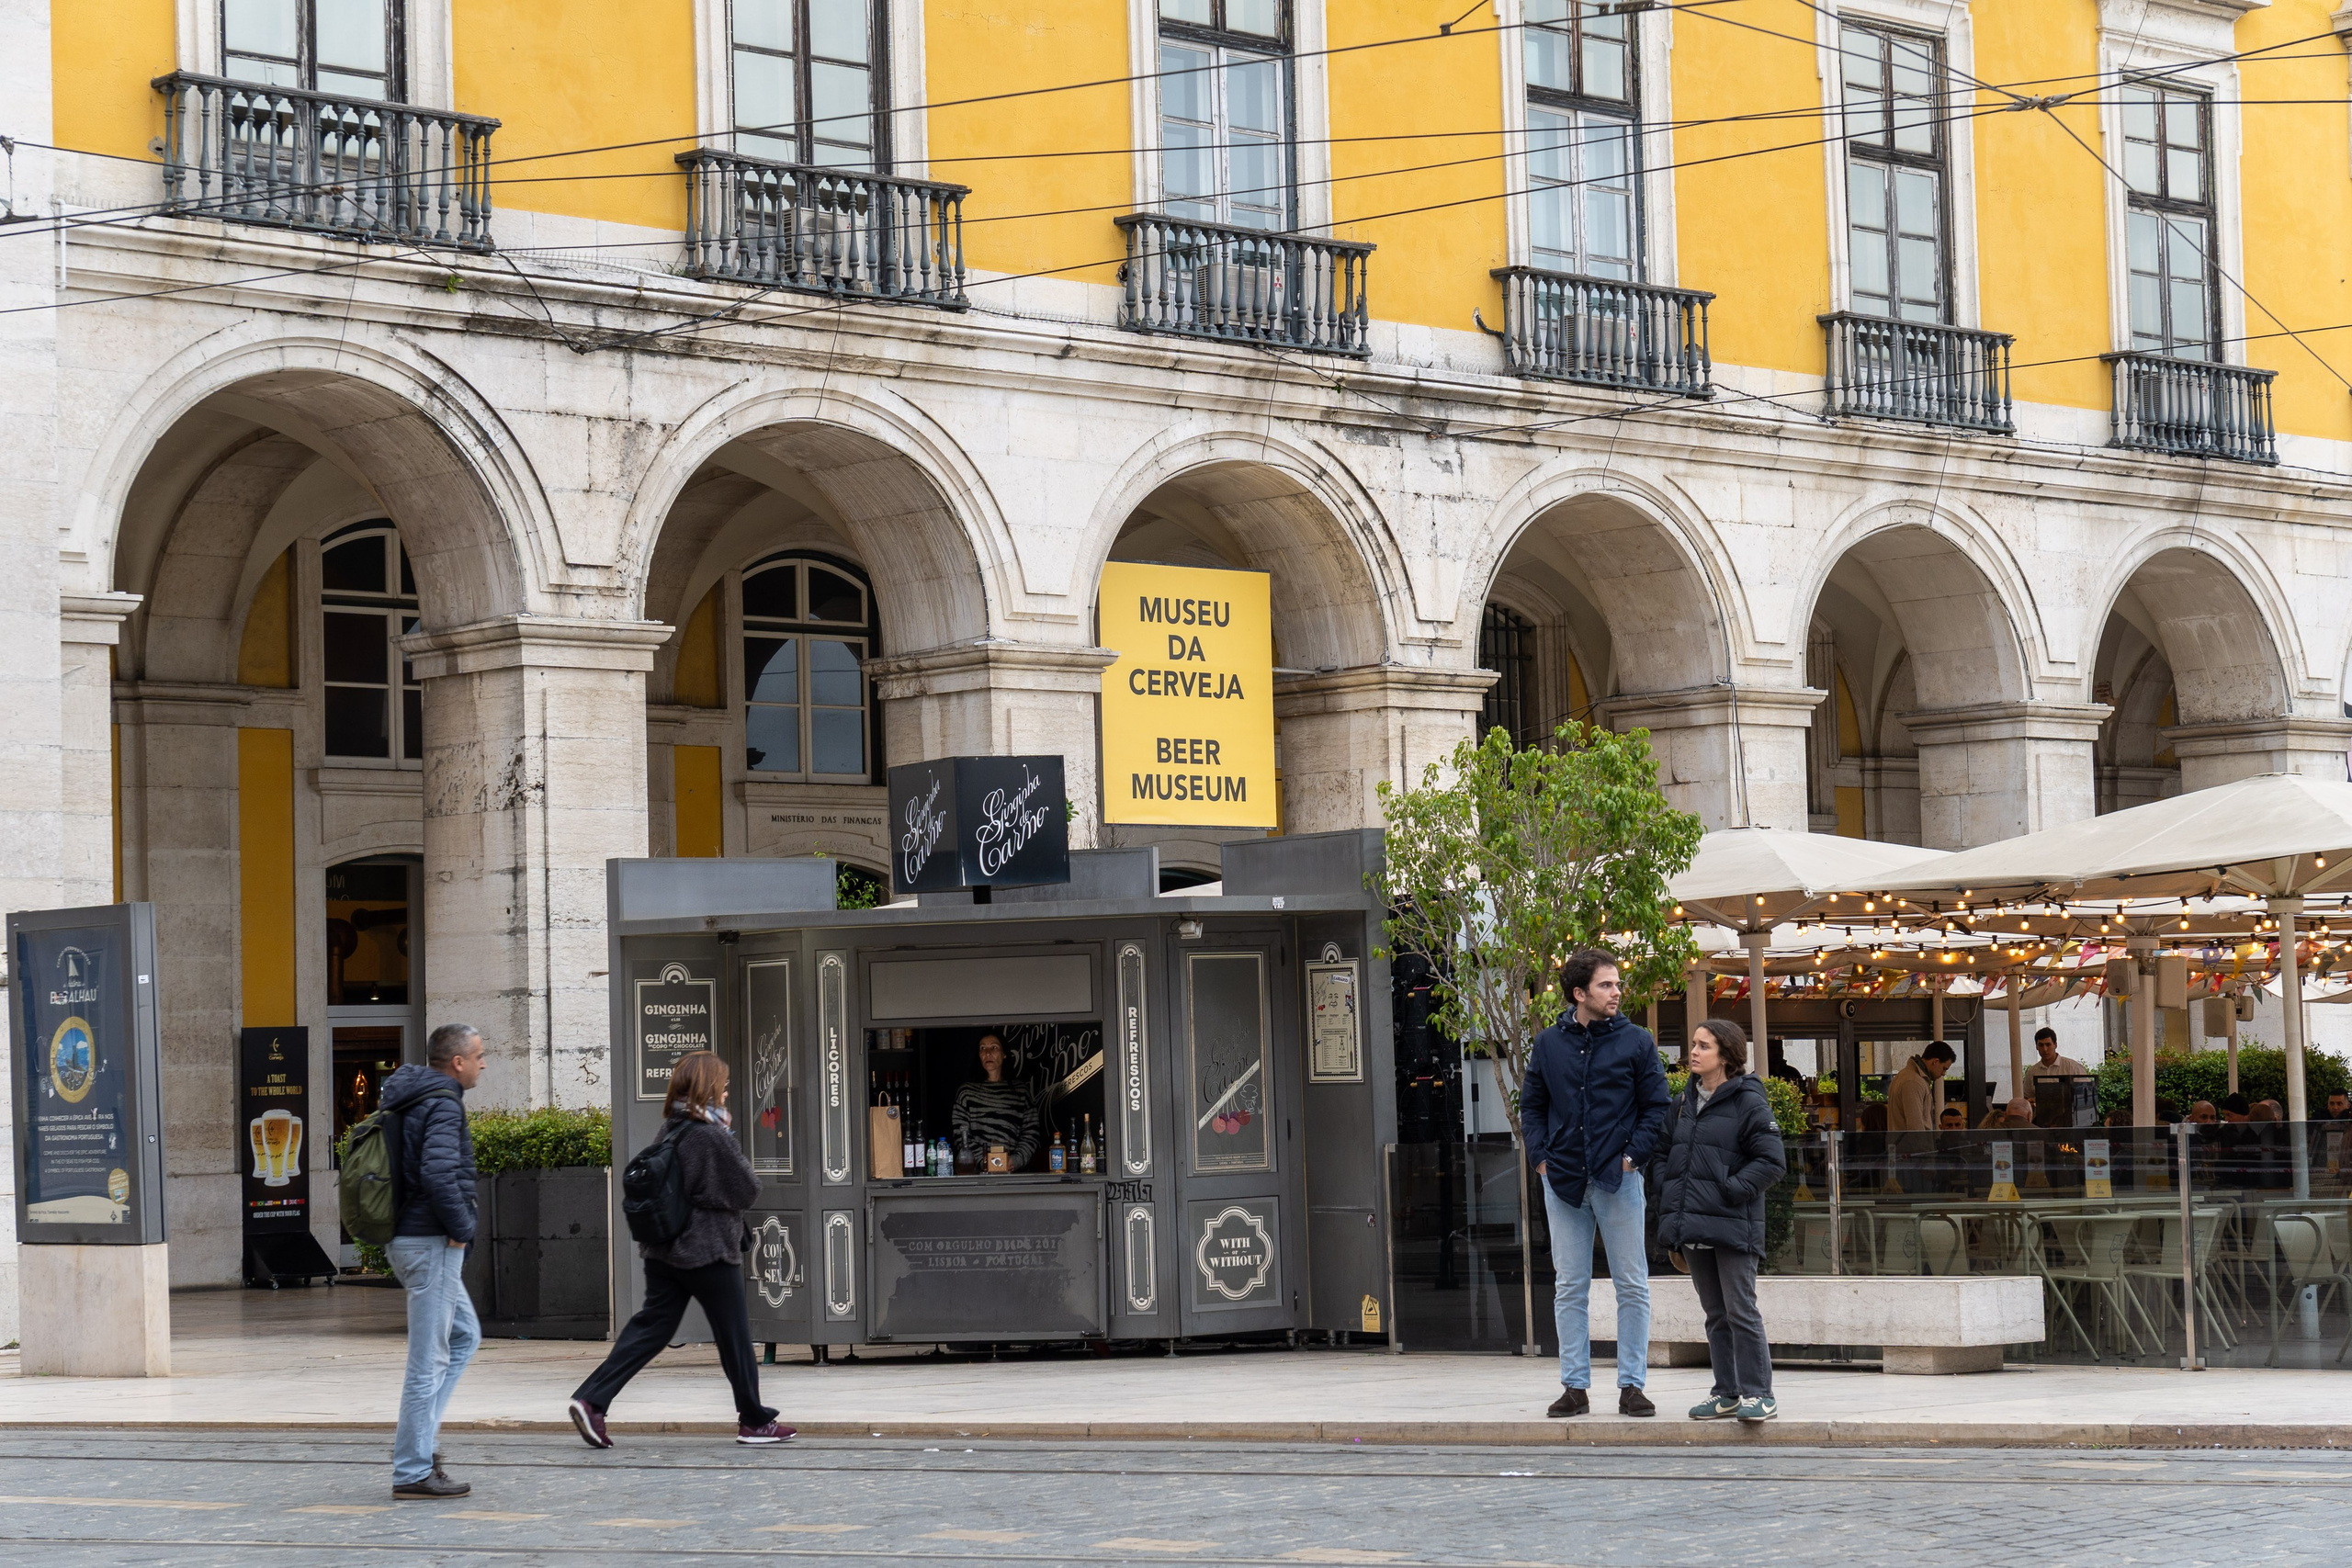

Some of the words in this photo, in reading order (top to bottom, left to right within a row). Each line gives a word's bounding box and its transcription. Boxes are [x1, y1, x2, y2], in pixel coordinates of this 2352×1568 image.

[1139, 595, 1230, 628] MUSEU
[1168, 634, 1206, 662] DA
[1128, 668, 1245, 701] CERVEJA
[1156, 737, 1221, 766] BEER
[1131, 773, 1247, 803] MUSEUM
[905, 769, 941, 850] Ginginha
[982, 763, 1042, 842] Ginginha
[771, 813, 815, 823] MINISTÉRIO
[821, 816, 837, 824] DAS
[901, 810, 947, 884] Carmo
[976, 806, 1050, 876] Carmo
[644, 1004, 707, 1015] GINGINHA
[645, 1032, 708, 1043] GINGINHA
[828, 1027, 840, 1107] LICORES
[1127, 1006, 1141, 1111] REFRESCOS
[251, 1087, 257, 1096] TO
[257, 1087, 268, 1096] THE
[268, 1086, 286, 1096] WHOLE
[286, 1085, 302, 1095] WORLD
[266, 1074, 271, 1084] A
[271, 1073, 287, 1084] TOAST
[908, 1241, 933, 1251] COM
[936, 1241, 991, 1251] ORGULHO
[1219, 1237, 1250, 1249] WITH
[928, 1257, 967, 1267] LISBOA
[985, 1254, 1045, 1267] PORTUGAL
[1209, 1254, 1262, 1268] WITHOUT
